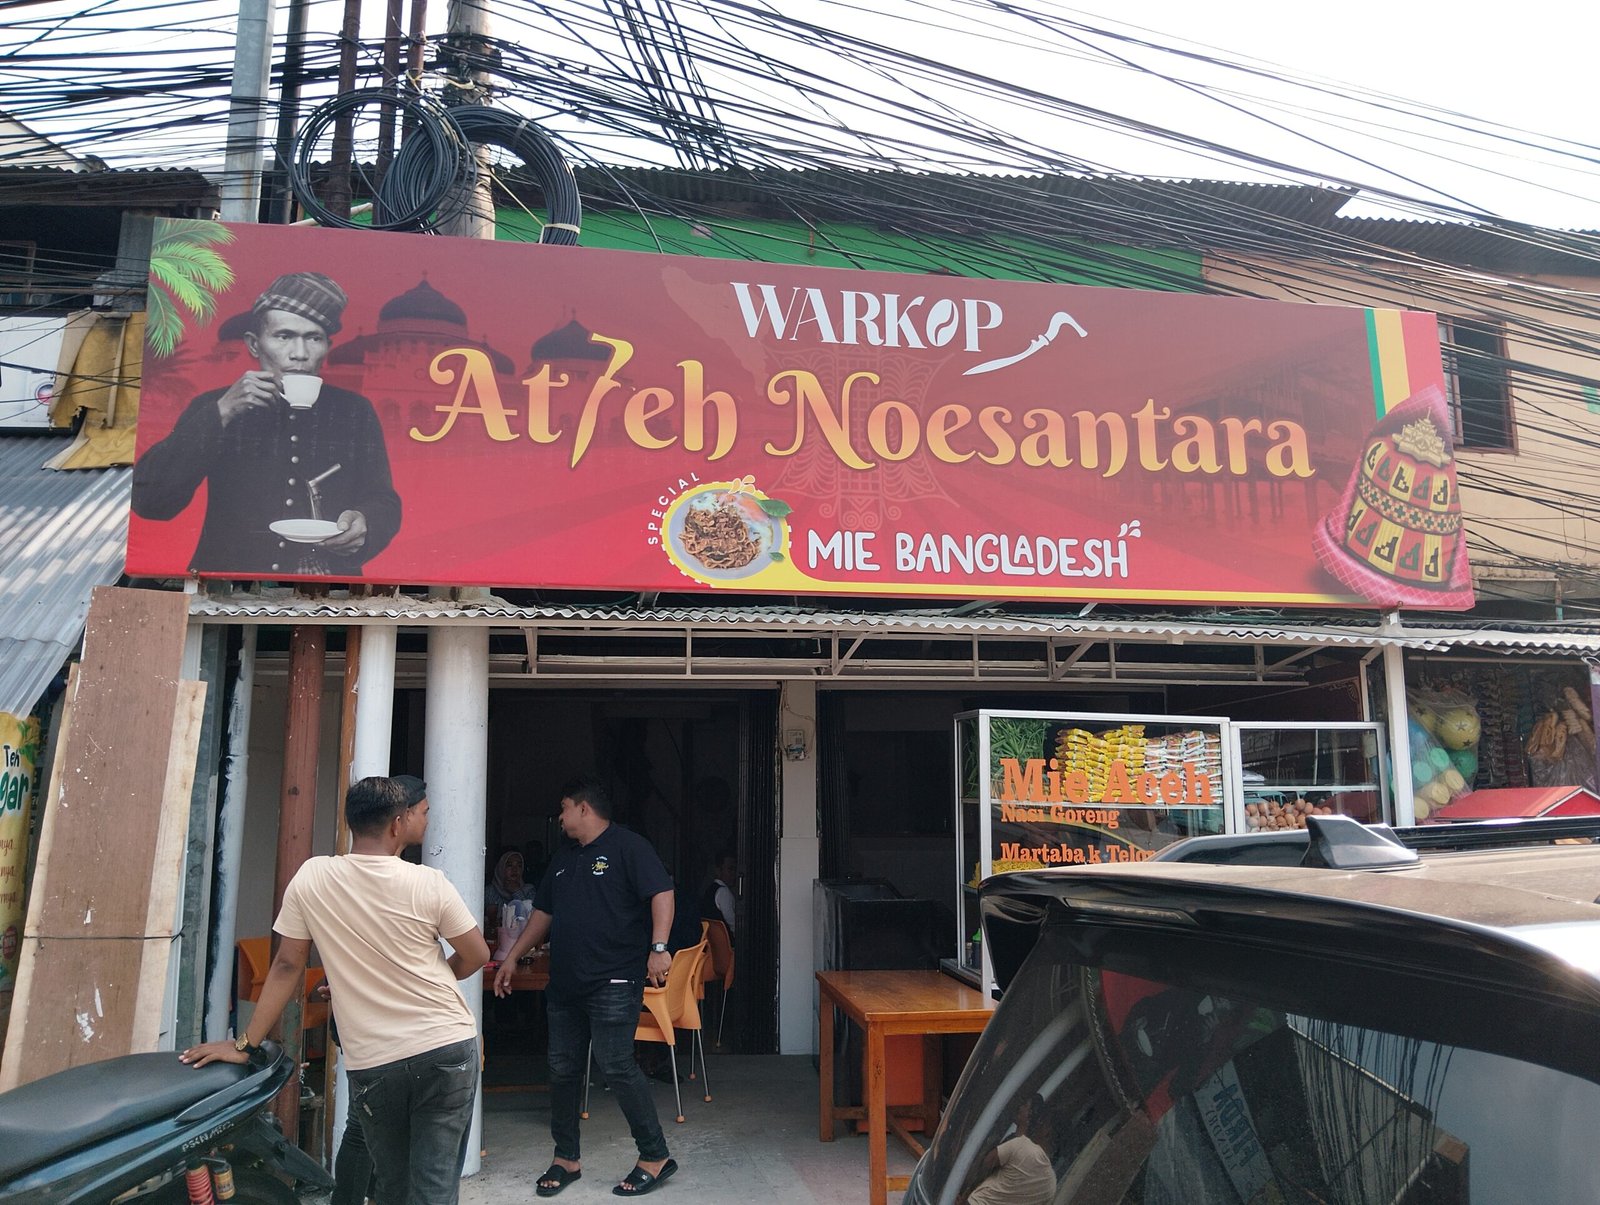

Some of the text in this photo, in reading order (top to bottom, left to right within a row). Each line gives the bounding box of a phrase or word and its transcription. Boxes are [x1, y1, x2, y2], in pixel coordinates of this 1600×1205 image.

[730, 282, 1003, 352] WARKOP
[764, 370, 1316, 479] Noesantara
[648, 472, 700, 545] SPECIAL
[808, 529, 1128, 578] MIE BANGLADESH
[1000, 758, 1214, 805] Mie Aceh
[1050, 805, 1120, 829] Goreng
